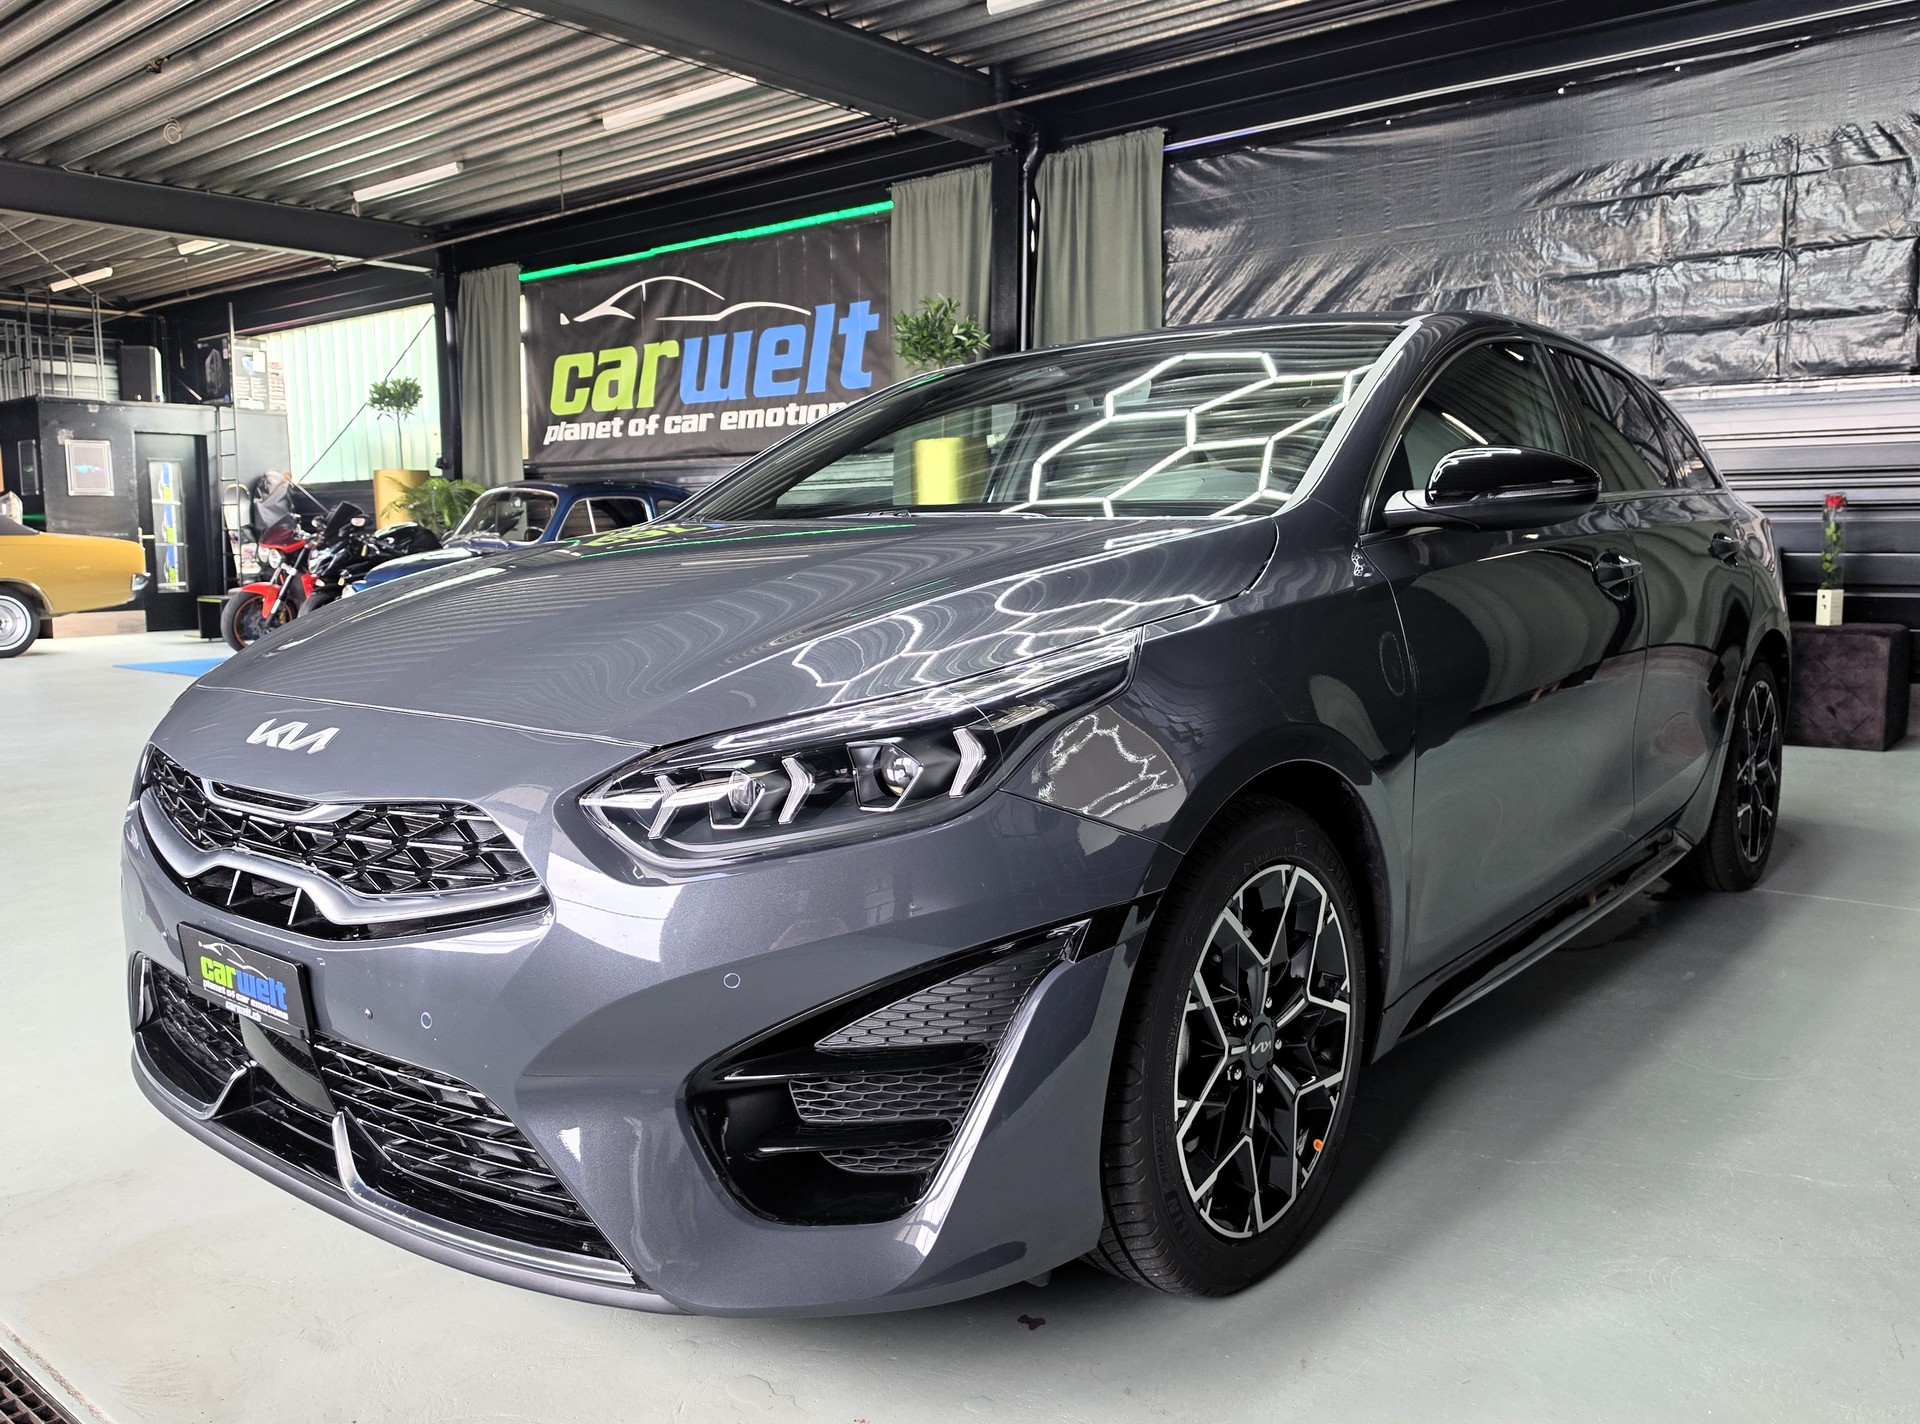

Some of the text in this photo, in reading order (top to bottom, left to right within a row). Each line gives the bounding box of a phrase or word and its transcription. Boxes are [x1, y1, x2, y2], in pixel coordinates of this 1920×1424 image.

[550, 301, 880, 416] carwelt
[543, 418, 623, 445] planet
[627, 414, 660, 436] of
[664, 412, 715, 435] car
[246, 717, 340, 754] KIA
[200, 956, 288, 1011] carwelt
[203, 980, 226, 995] planet
[236, 993, 250, 1004] car
[250, 999, 289, 1020] emotions
